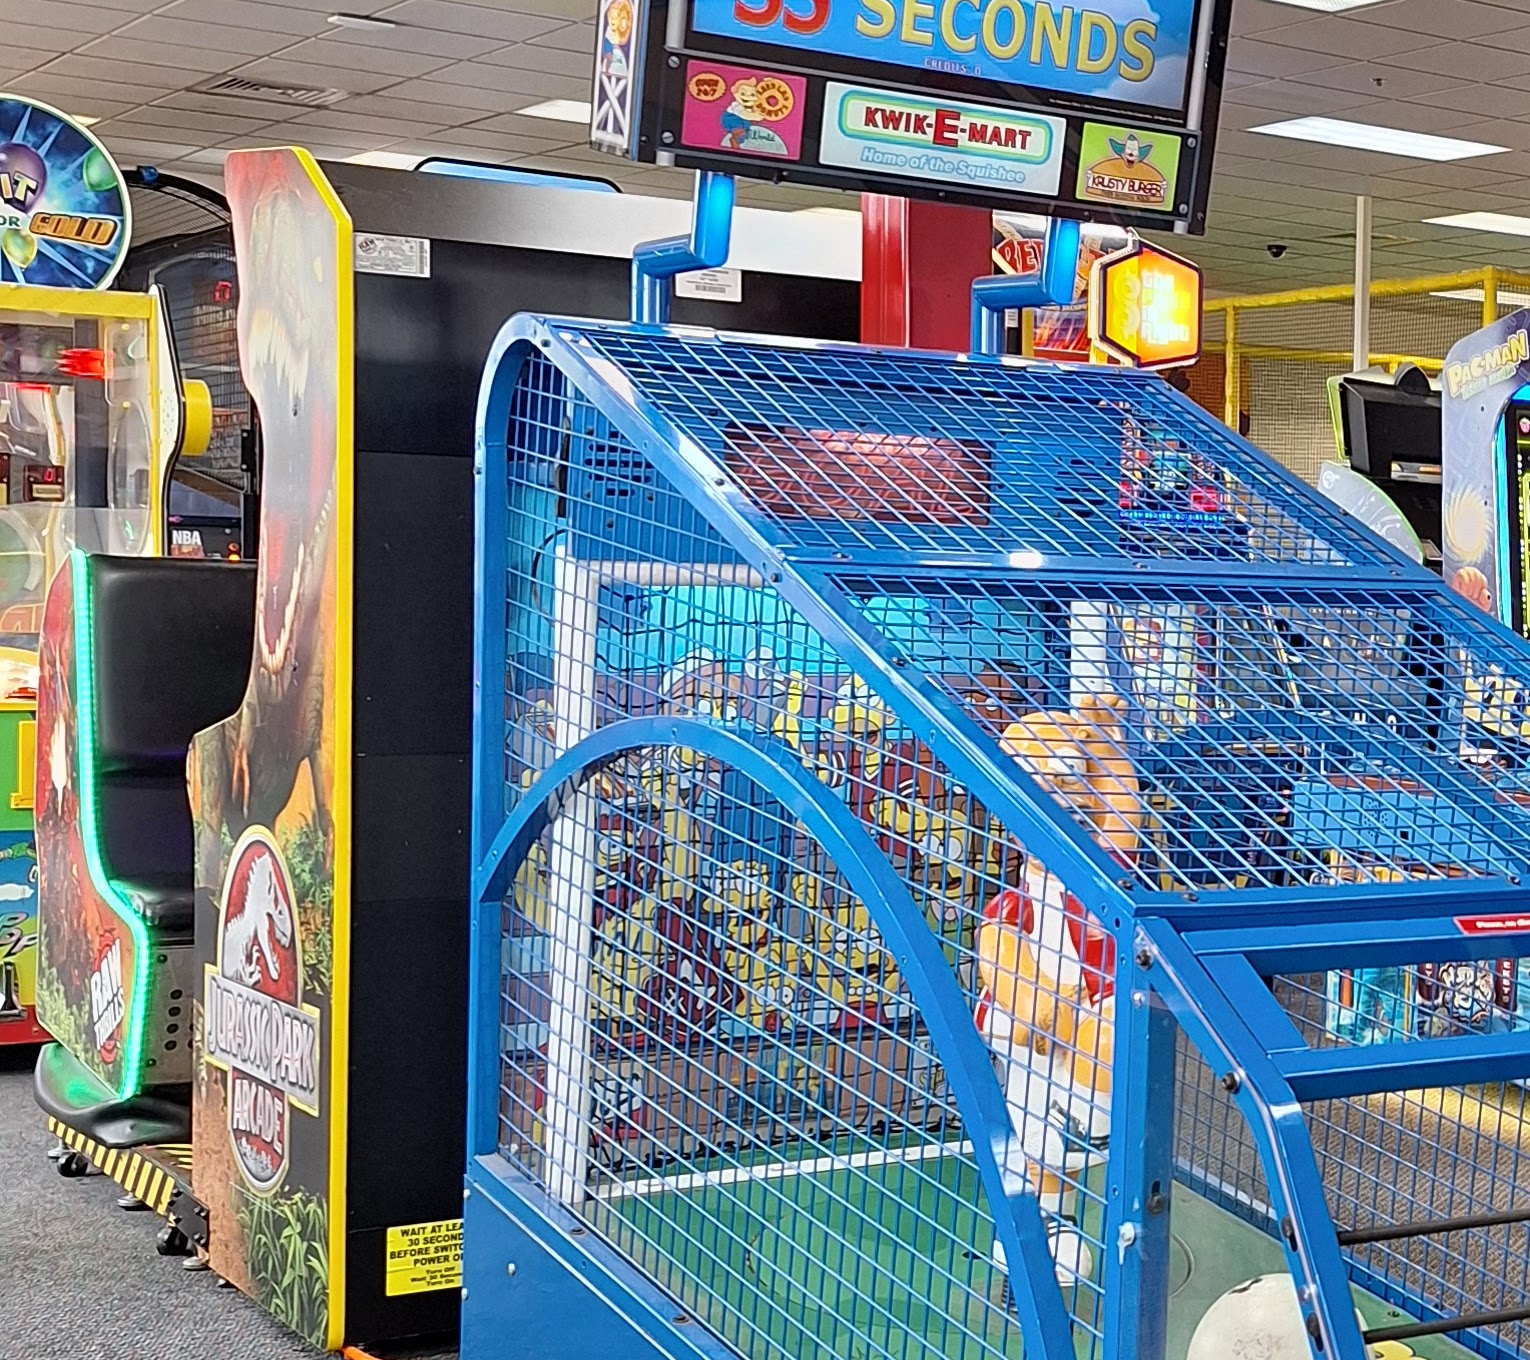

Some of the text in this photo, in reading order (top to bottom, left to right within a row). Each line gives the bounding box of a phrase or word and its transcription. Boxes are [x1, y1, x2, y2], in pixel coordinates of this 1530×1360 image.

[863, 105, 1032, 148] KWIK-E-MART
[861, 146, 1026, 184] Home of the Squishee
[1092, 174, 1128, 191] KRUSTY
[171, 529, 202, 546] NBA
[90, 938, 124, 1023] RAW
[207, 976, 316, 1092] JURASSIC PARK
[232, 1078, 284, 1156] ARCADE
[401, 1222, 464, 1237] WAIT AT LEA
[407, 1233, 464, 1247] 30 SECOND
[389, 1242, 464, 1260] BEFORE SWITC
[413, 1254, 451, 1267] POWER
